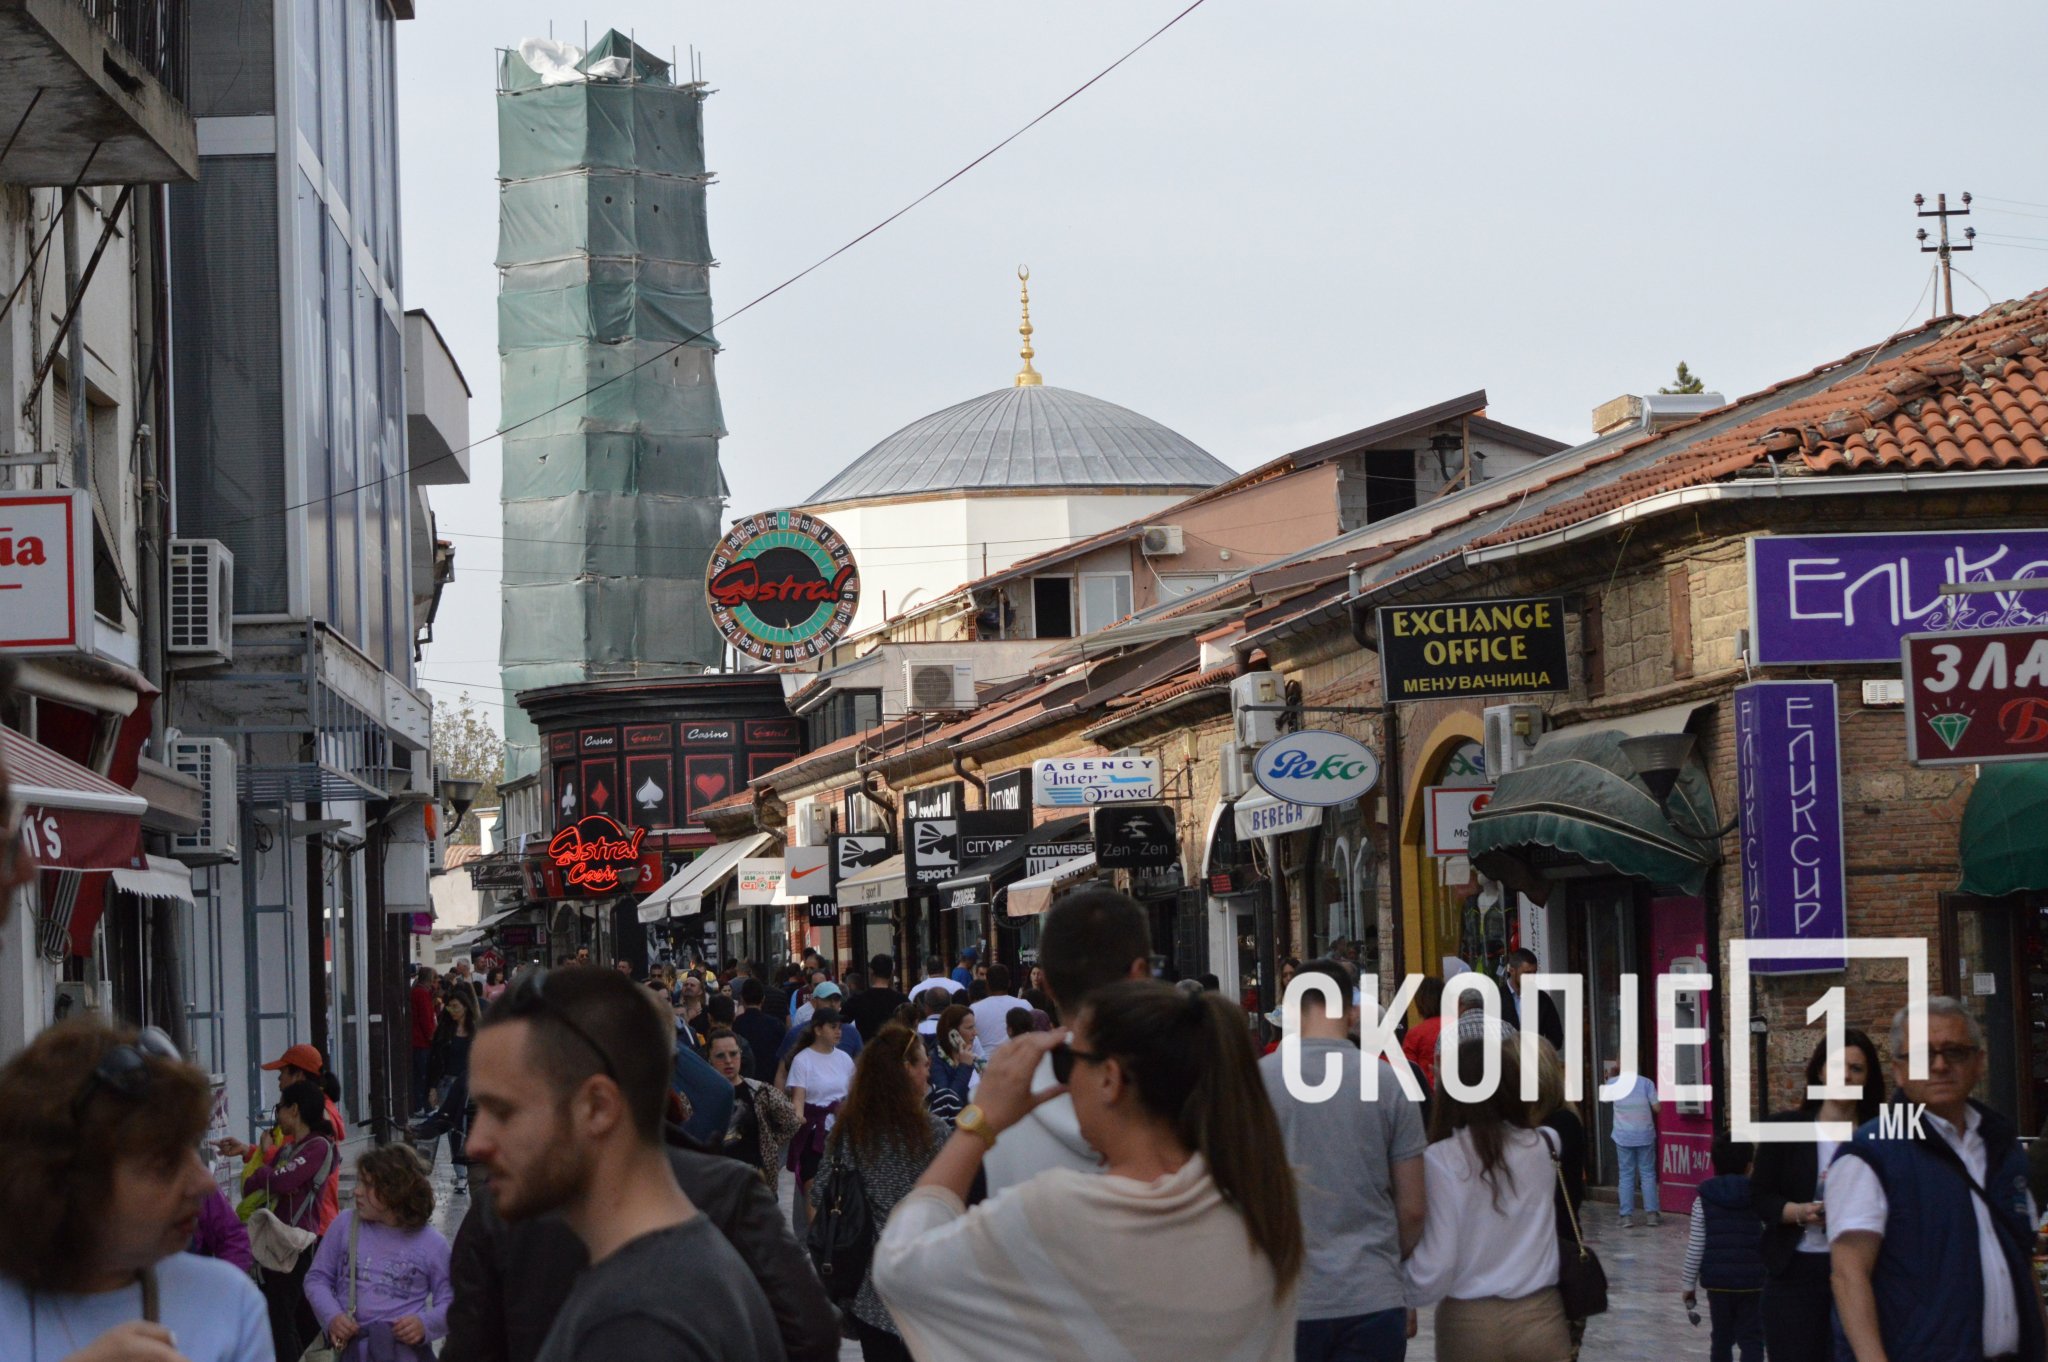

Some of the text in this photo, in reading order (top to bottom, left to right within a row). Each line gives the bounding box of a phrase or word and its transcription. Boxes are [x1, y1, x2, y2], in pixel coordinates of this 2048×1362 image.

[801, 519, 810, 530] 15
[1393, 603, 1552, 637] EXCHANGE
[1423, 635, 1528, 666] OFFICE
[1403, 670, 1551, 693] МЕНУВАЧНИЦА
[584, 736, 613, 746] Casino
[687, 728, 729, 740] Casino
[1043, 760, 1153, 772] AGENCY
[1043, 772, 1098, 786] Inter
[1084, 784, 1154, 803] Travel
[1252, 804, 1303, 831] BEBEGA
[1029, 843, 1093, 856] CONVERSE
[1103, 842, 1168, 857] Zen Zen
[641, 865, 653, 882] 3
[916, 866, 953, 882] sport
[810, 903, 837, 917] ICON
[1662, 1143, 1690, 1174] ATM
